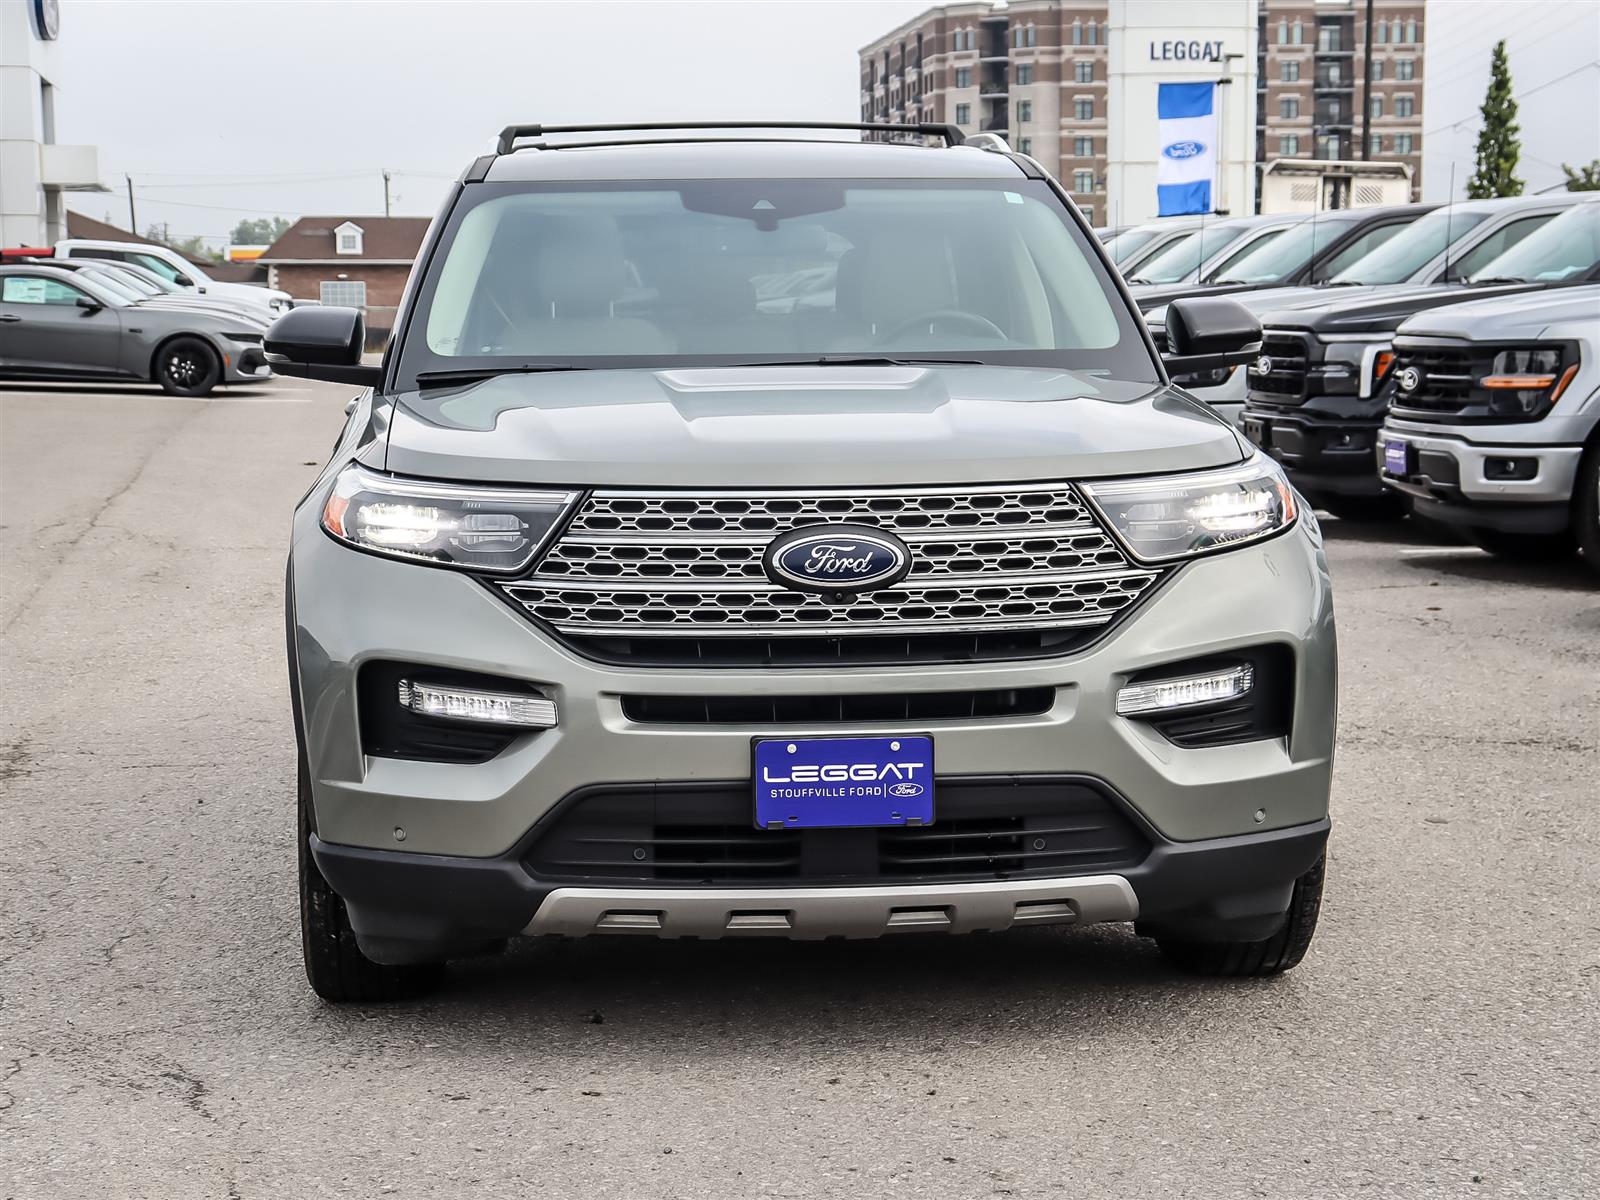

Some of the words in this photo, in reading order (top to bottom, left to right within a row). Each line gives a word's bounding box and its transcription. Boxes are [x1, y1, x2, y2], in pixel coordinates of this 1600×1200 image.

[1150, 41, 1224, 61] LEGGAT
[804, 545, 874, 573] Ford
[763, 763, 924, 783] LEGGAT
[770, 788, 845, 798] STOUFFVILLE
[850, 786, 882, 797] FORD
[895, 784, 917, 795] Ford
